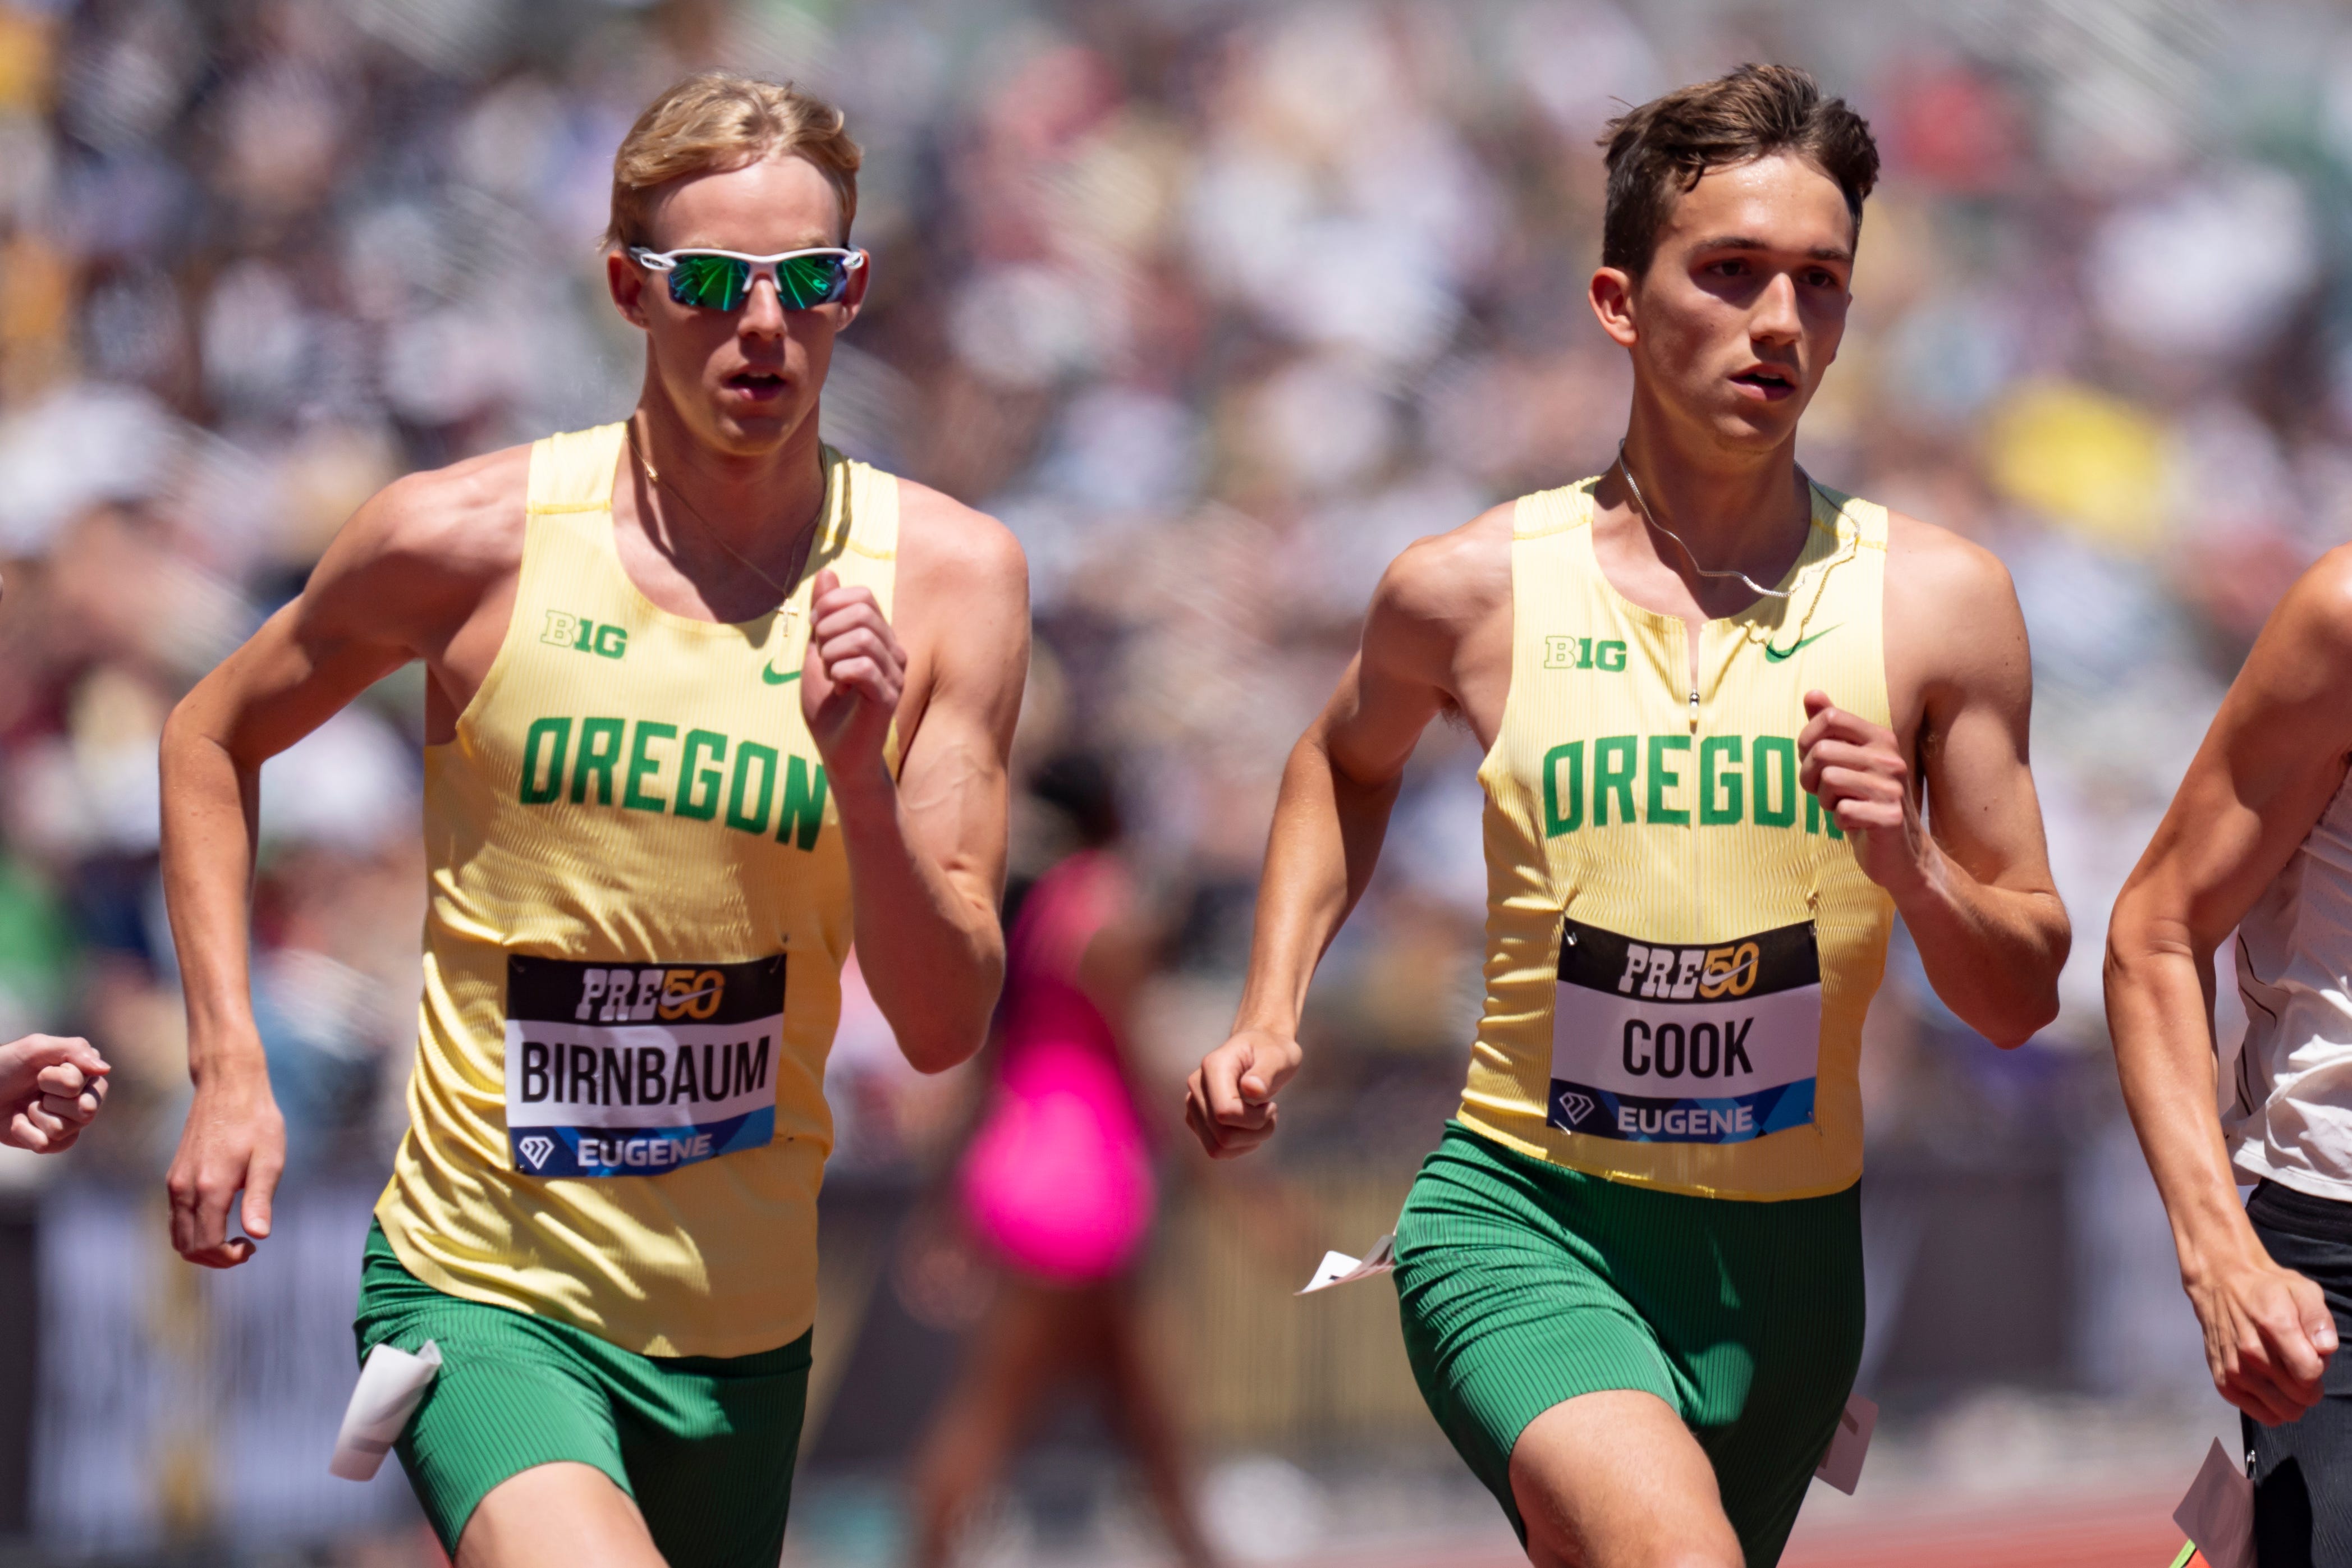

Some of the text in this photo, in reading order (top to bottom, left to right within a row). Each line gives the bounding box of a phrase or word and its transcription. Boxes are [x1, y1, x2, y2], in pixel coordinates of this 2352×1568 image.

[520, 717, 828, 852] OREGON
[521, 1035, 771, 1107] BIRNBAUM
[1622, 1017, 1755, 1079] COOK
[577, 1134, 712, 1167] EUGENE
[1617, 1104, 1754, 1135] EUGENE
